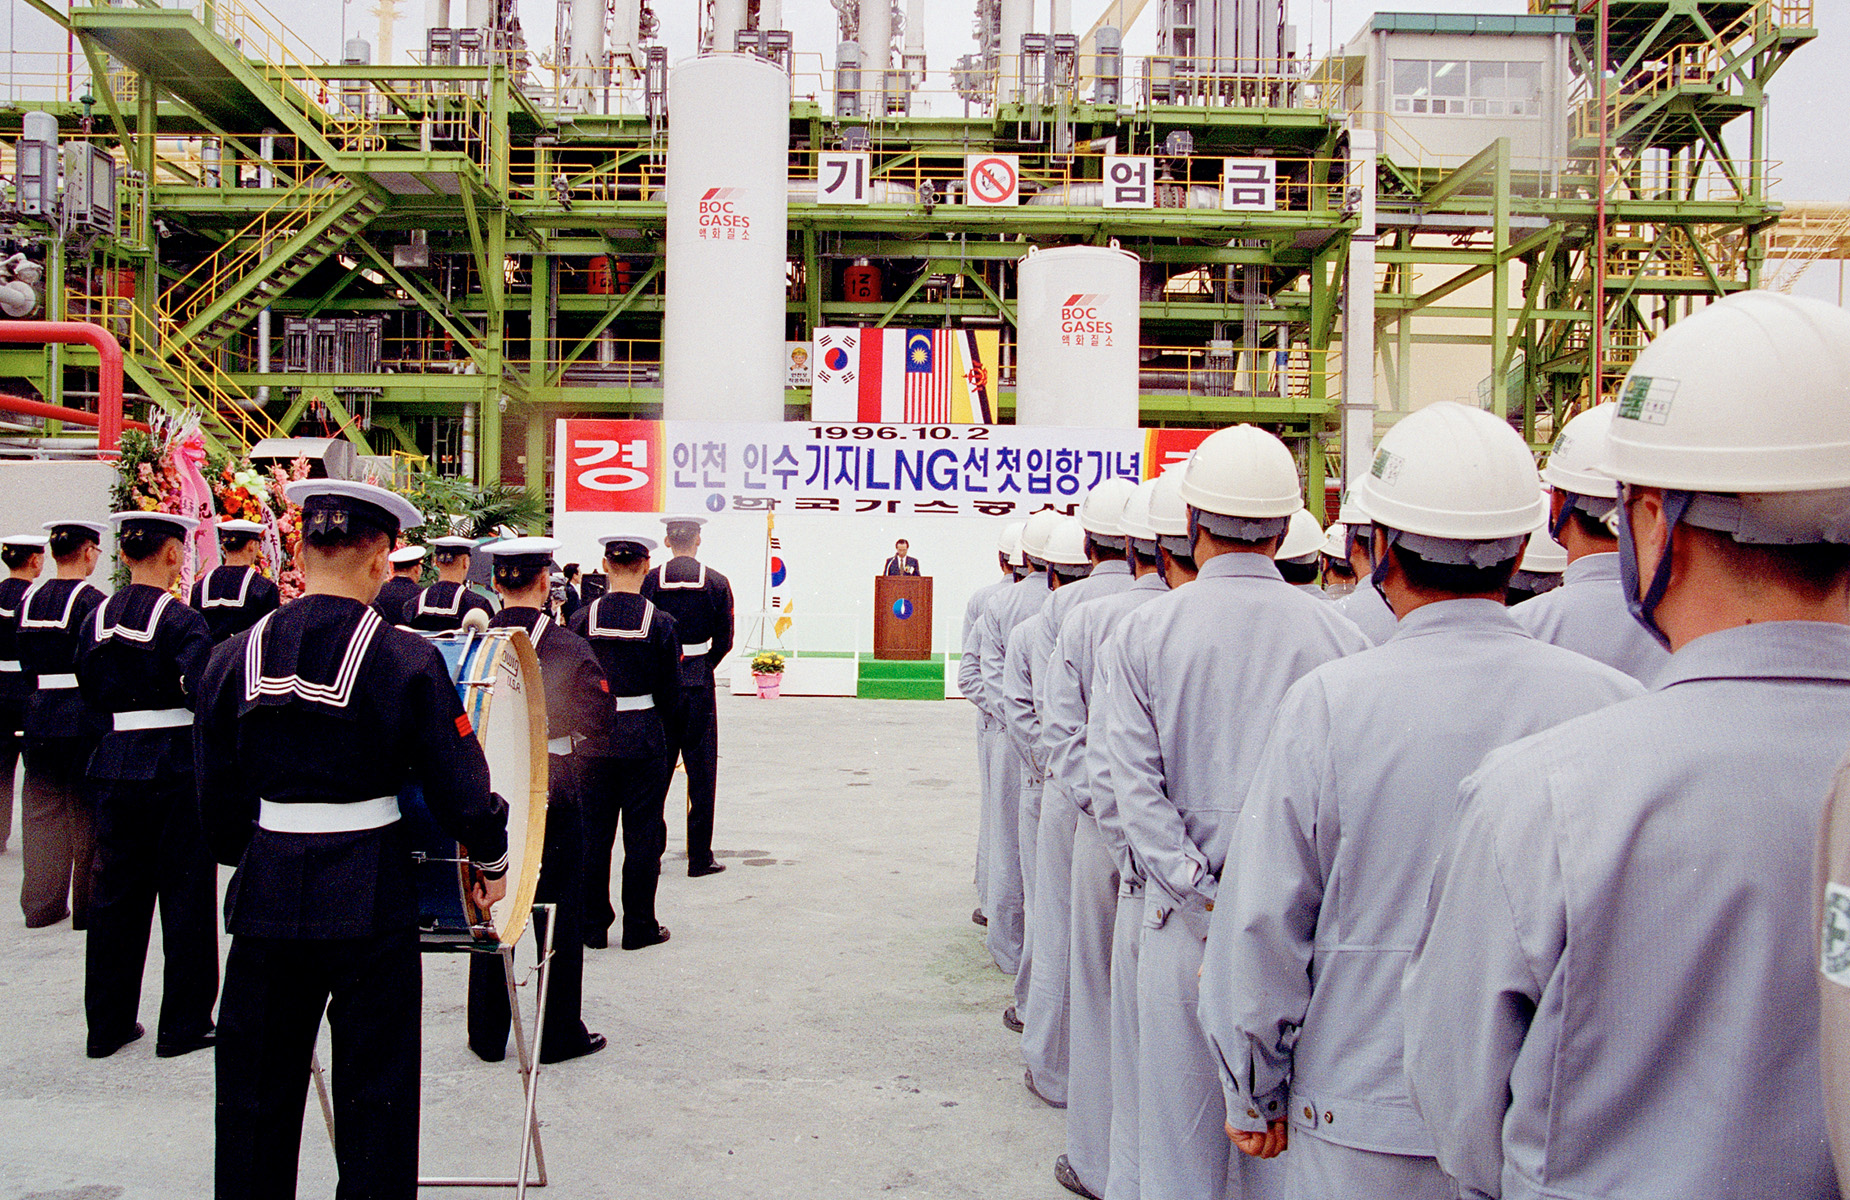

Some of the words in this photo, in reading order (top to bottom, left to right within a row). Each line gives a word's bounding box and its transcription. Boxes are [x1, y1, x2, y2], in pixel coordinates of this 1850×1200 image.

[824, 159, 863, 200] 기
[1110, 162, 1147, 203] 엄
[1228, 164, 1271, 205] 금
[699, 201, 734, 213] BOC
[699, 214, 750, 228] GASES
[859, 274, 871, 297] NG
[1061, 307, 1097, 320] BOC
[1061, 321, 1113, 334] GASES
[574, 439, 650, 492] 경
[672, 441, 727, 488] 인천
